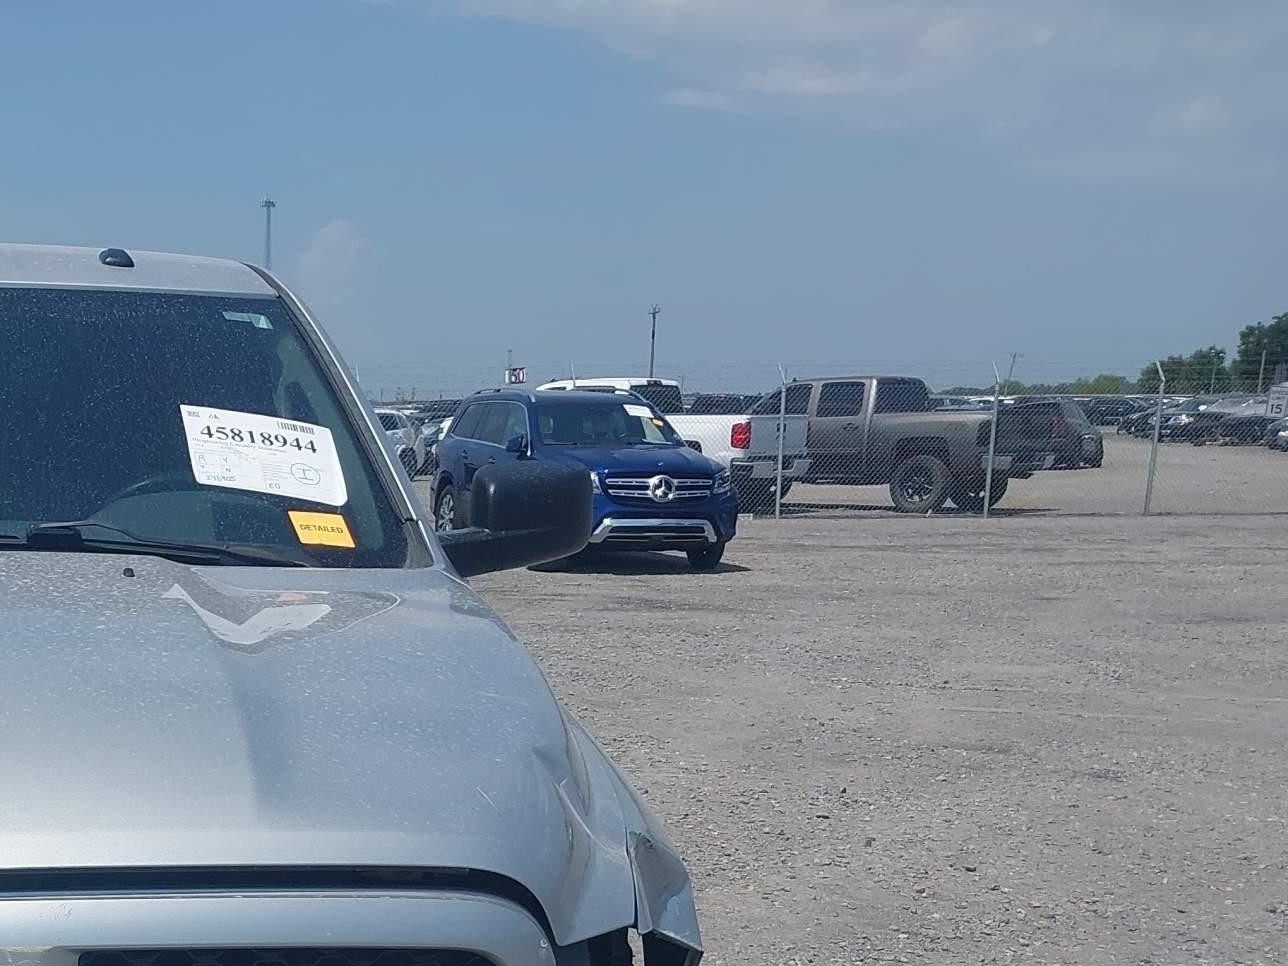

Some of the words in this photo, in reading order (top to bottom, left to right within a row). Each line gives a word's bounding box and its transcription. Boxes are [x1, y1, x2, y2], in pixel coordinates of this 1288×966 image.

[1270, 403, 1284, 414] 15
[200, 425, 317, 454] 45818944
[299, 523, 344, 534] DETAILED
